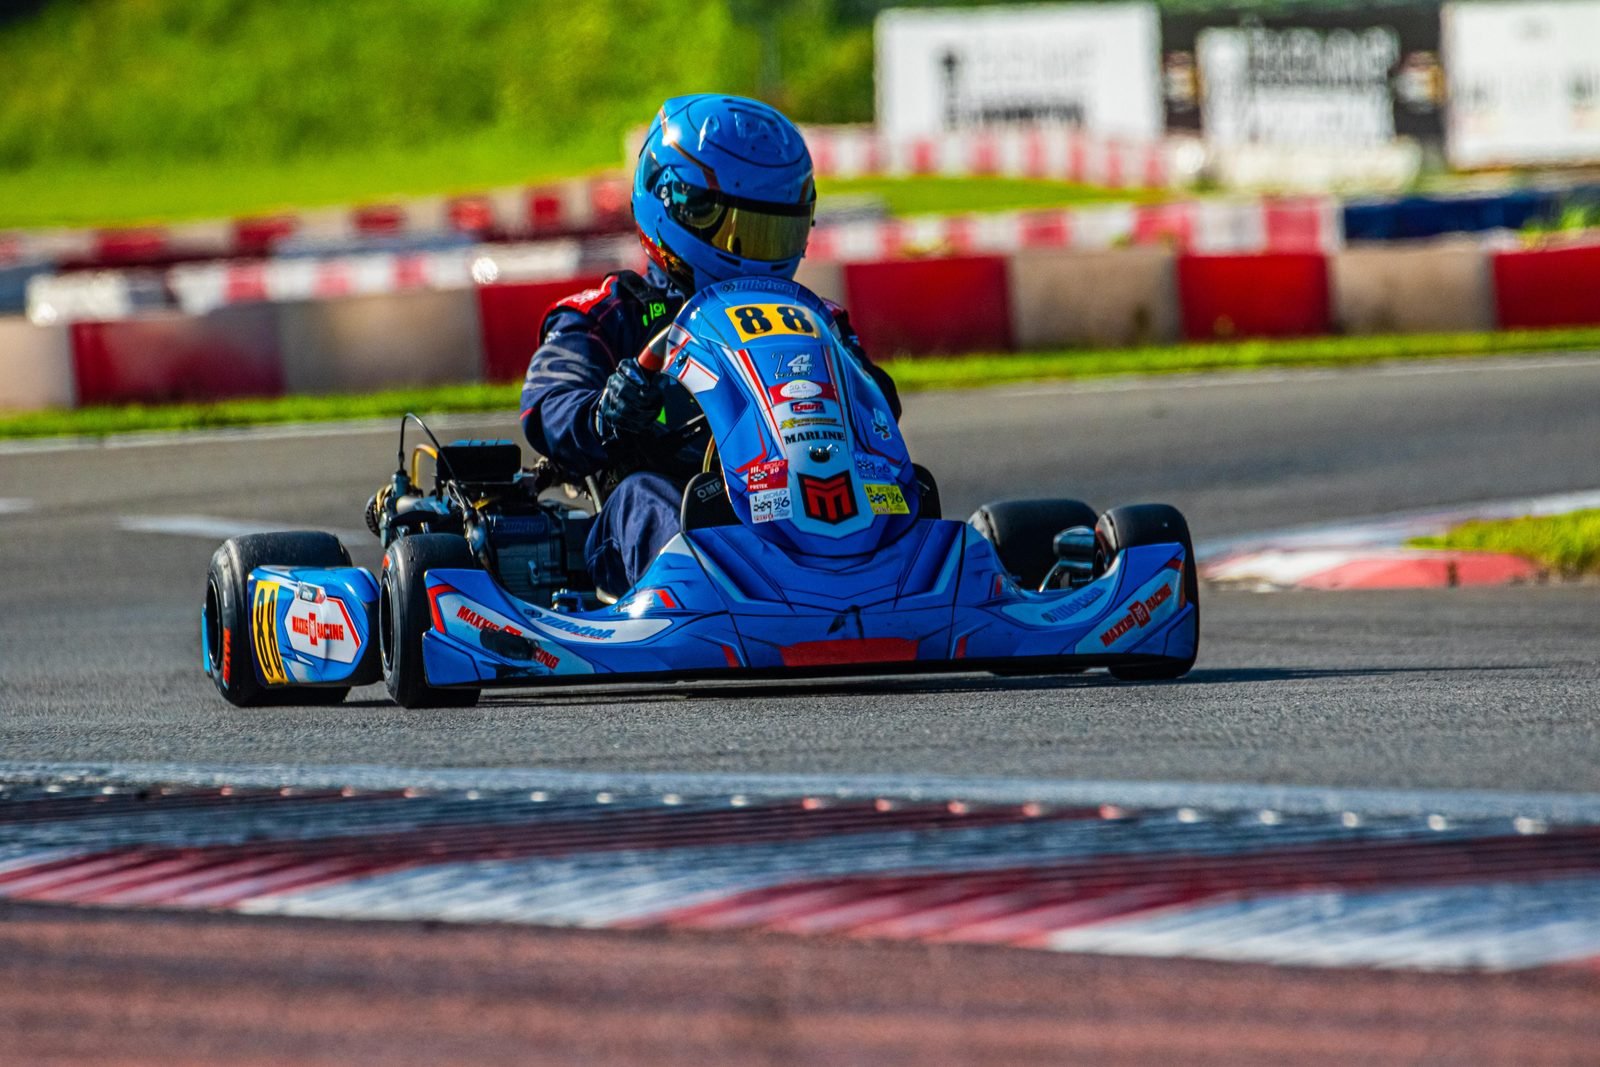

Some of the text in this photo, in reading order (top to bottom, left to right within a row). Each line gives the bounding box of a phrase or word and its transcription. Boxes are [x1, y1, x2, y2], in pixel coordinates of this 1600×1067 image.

[734, 306, 814, 335] 88
[784, 430, 846, 445] MARLINE
[696, 480, 722, 499] OMP
